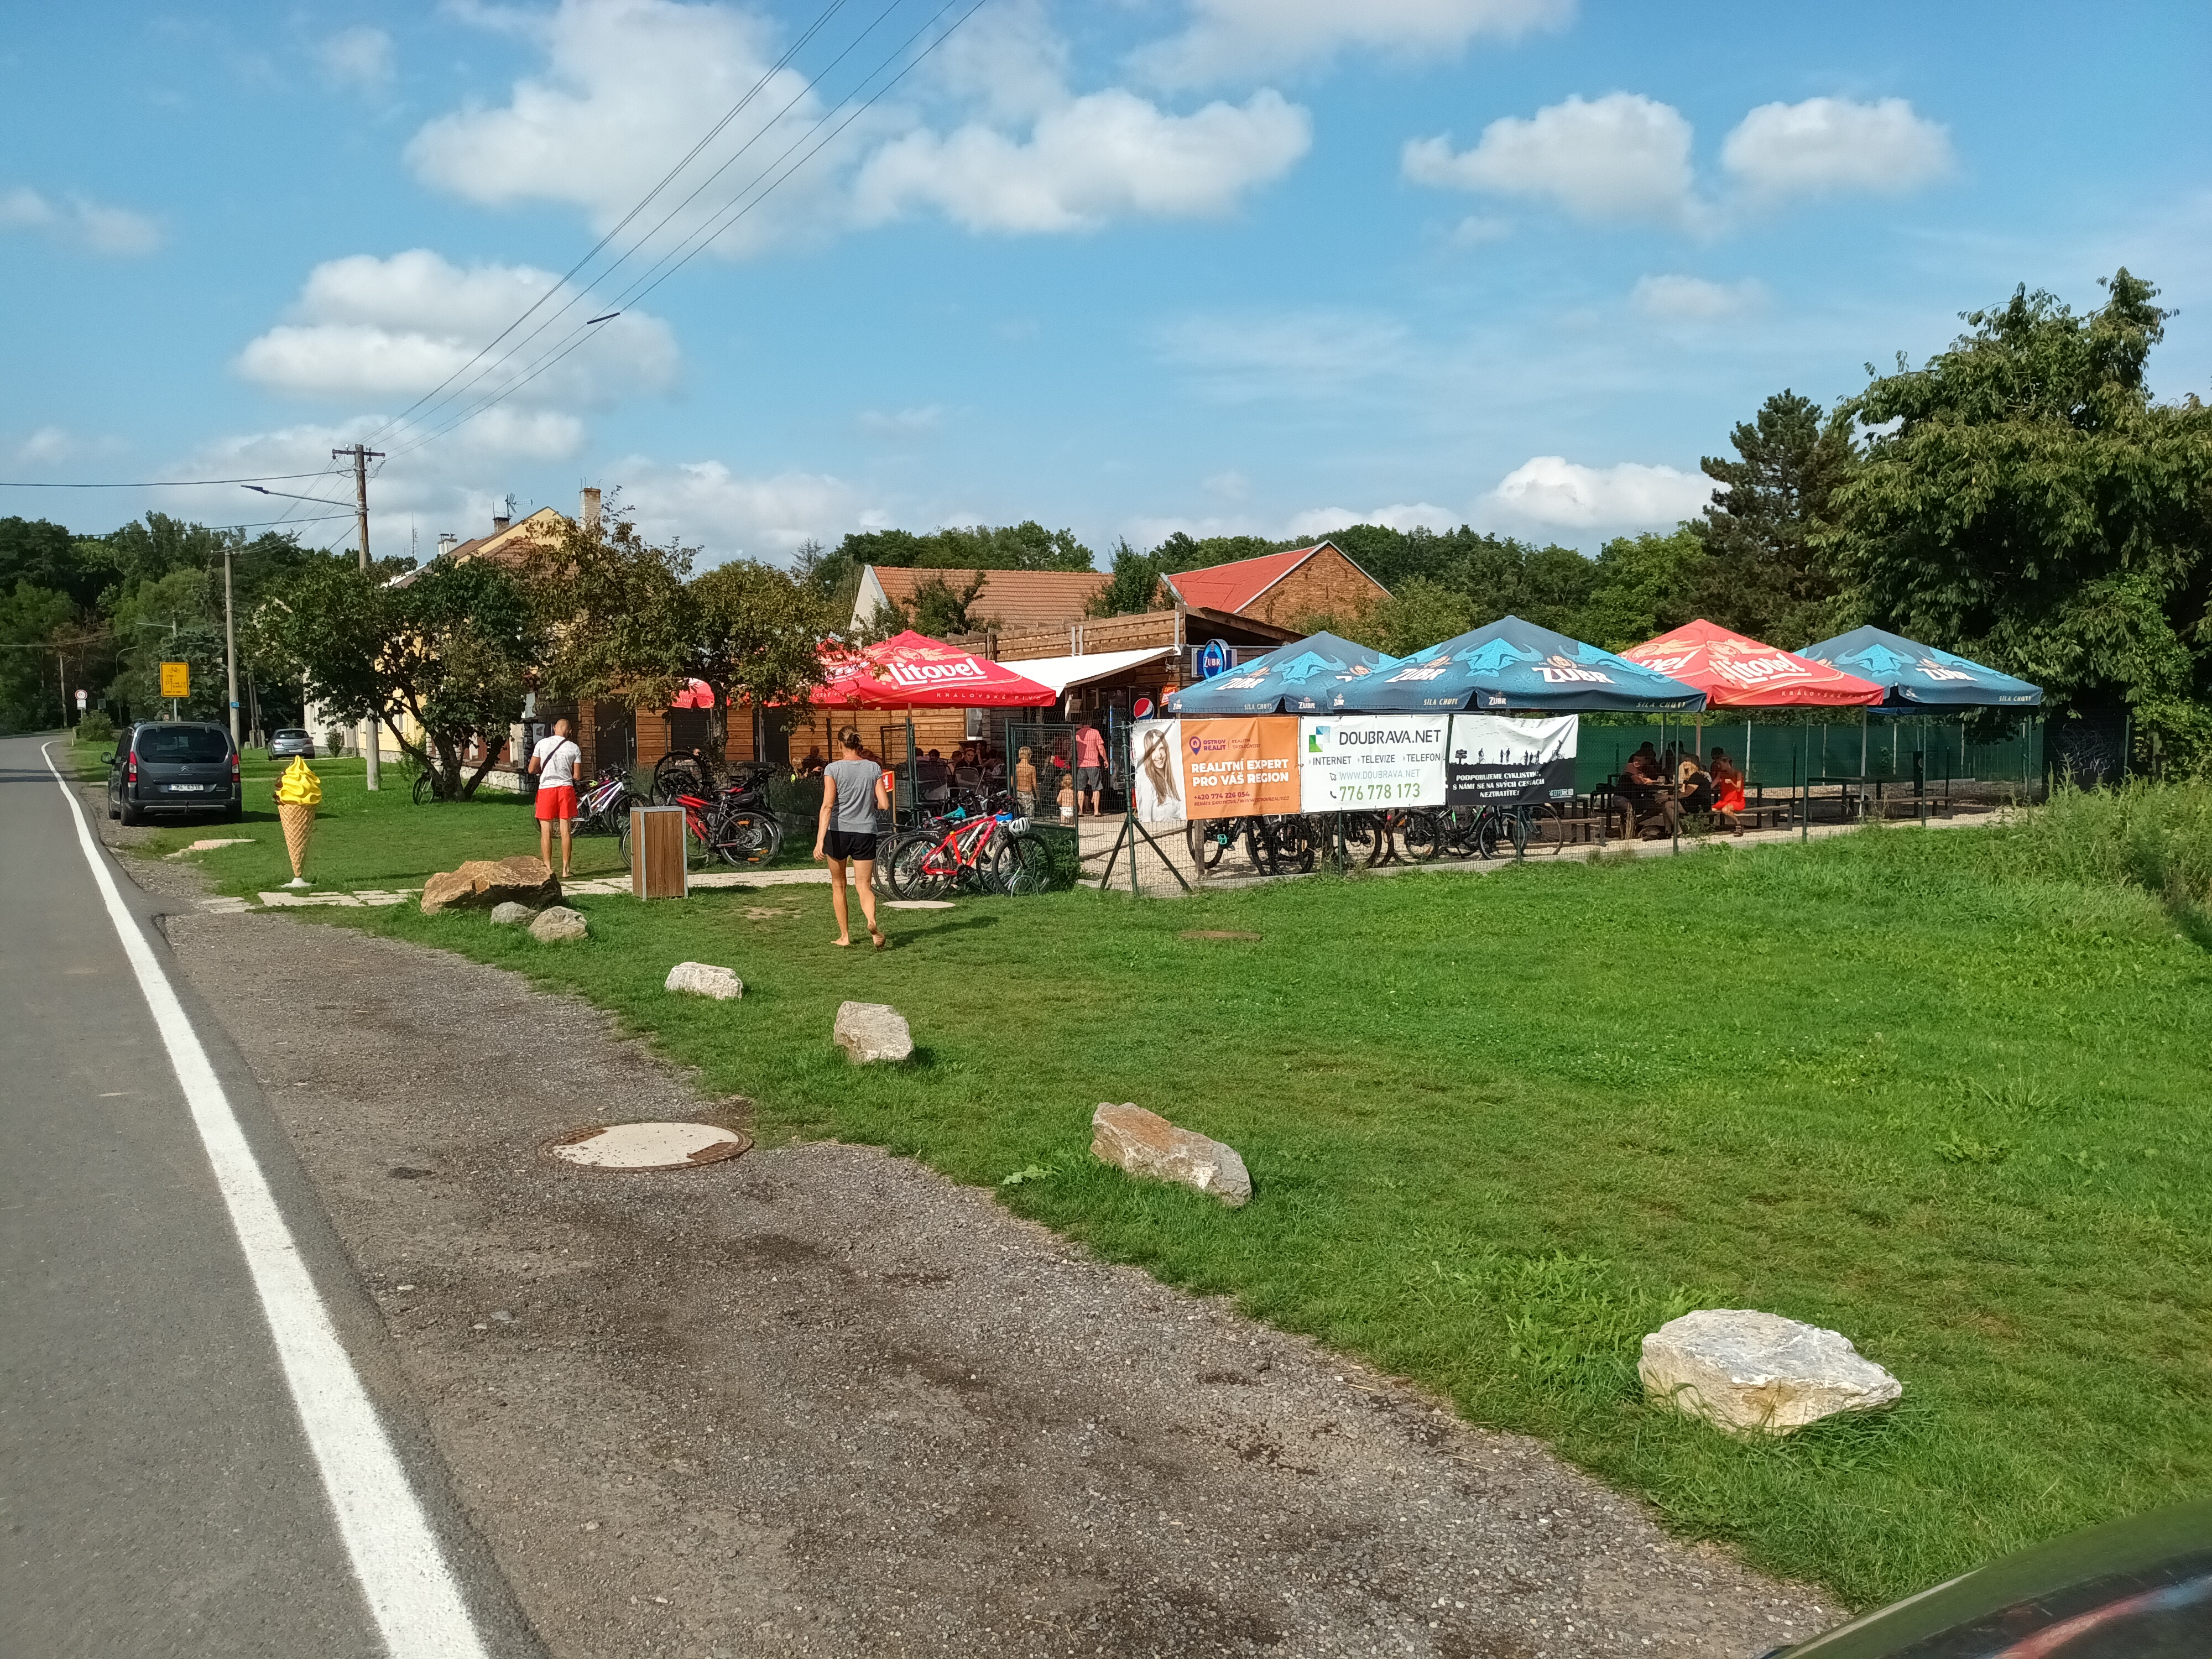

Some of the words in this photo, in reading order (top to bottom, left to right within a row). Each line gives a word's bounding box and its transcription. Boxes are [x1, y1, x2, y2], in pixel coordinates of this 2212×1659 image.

[1204, 656, 1220, 666] ZUBR
[886, 658, 987, 686] Litovel
[1384, 668, 1446, 682] ZUBR
[1531, 667, 1616, 684] ZUBR
[1716, 653, 1812, 684] Litovel
[936, 690, 1006, 700] KRÁLOVSKÉ
[1489, 697, 1506, 706] ZUBR
[1339, 729, 1441, 745] DOUBRAVA.NET
[1191, 758, 1244, 773] REALITNÍ
[1246, 759, 1289, 770] EXPERT
[1313, 756, 1352, 765] INTERNET
[1361, 754, 1395, 764] TELEVIZE
[1406, 753, 1441, 763] TELEFON
[1192, 776, 1218, 787] PRO
[1220, 772, 1245, 785] VÁŠ
[1246, 772, 1289, 784] REGION
[1339, 769, 1420, 780] WWW.DOUBRAVA.NET
[1495, 780, 1516, 789] SVÝCH
[1517, 778, 1545, 787] CESTÁCH
[1339, 785, 1363, 801] 776
[1368, 784, 1391, 800] 778
[1397, 783, 1420, 799] 173
